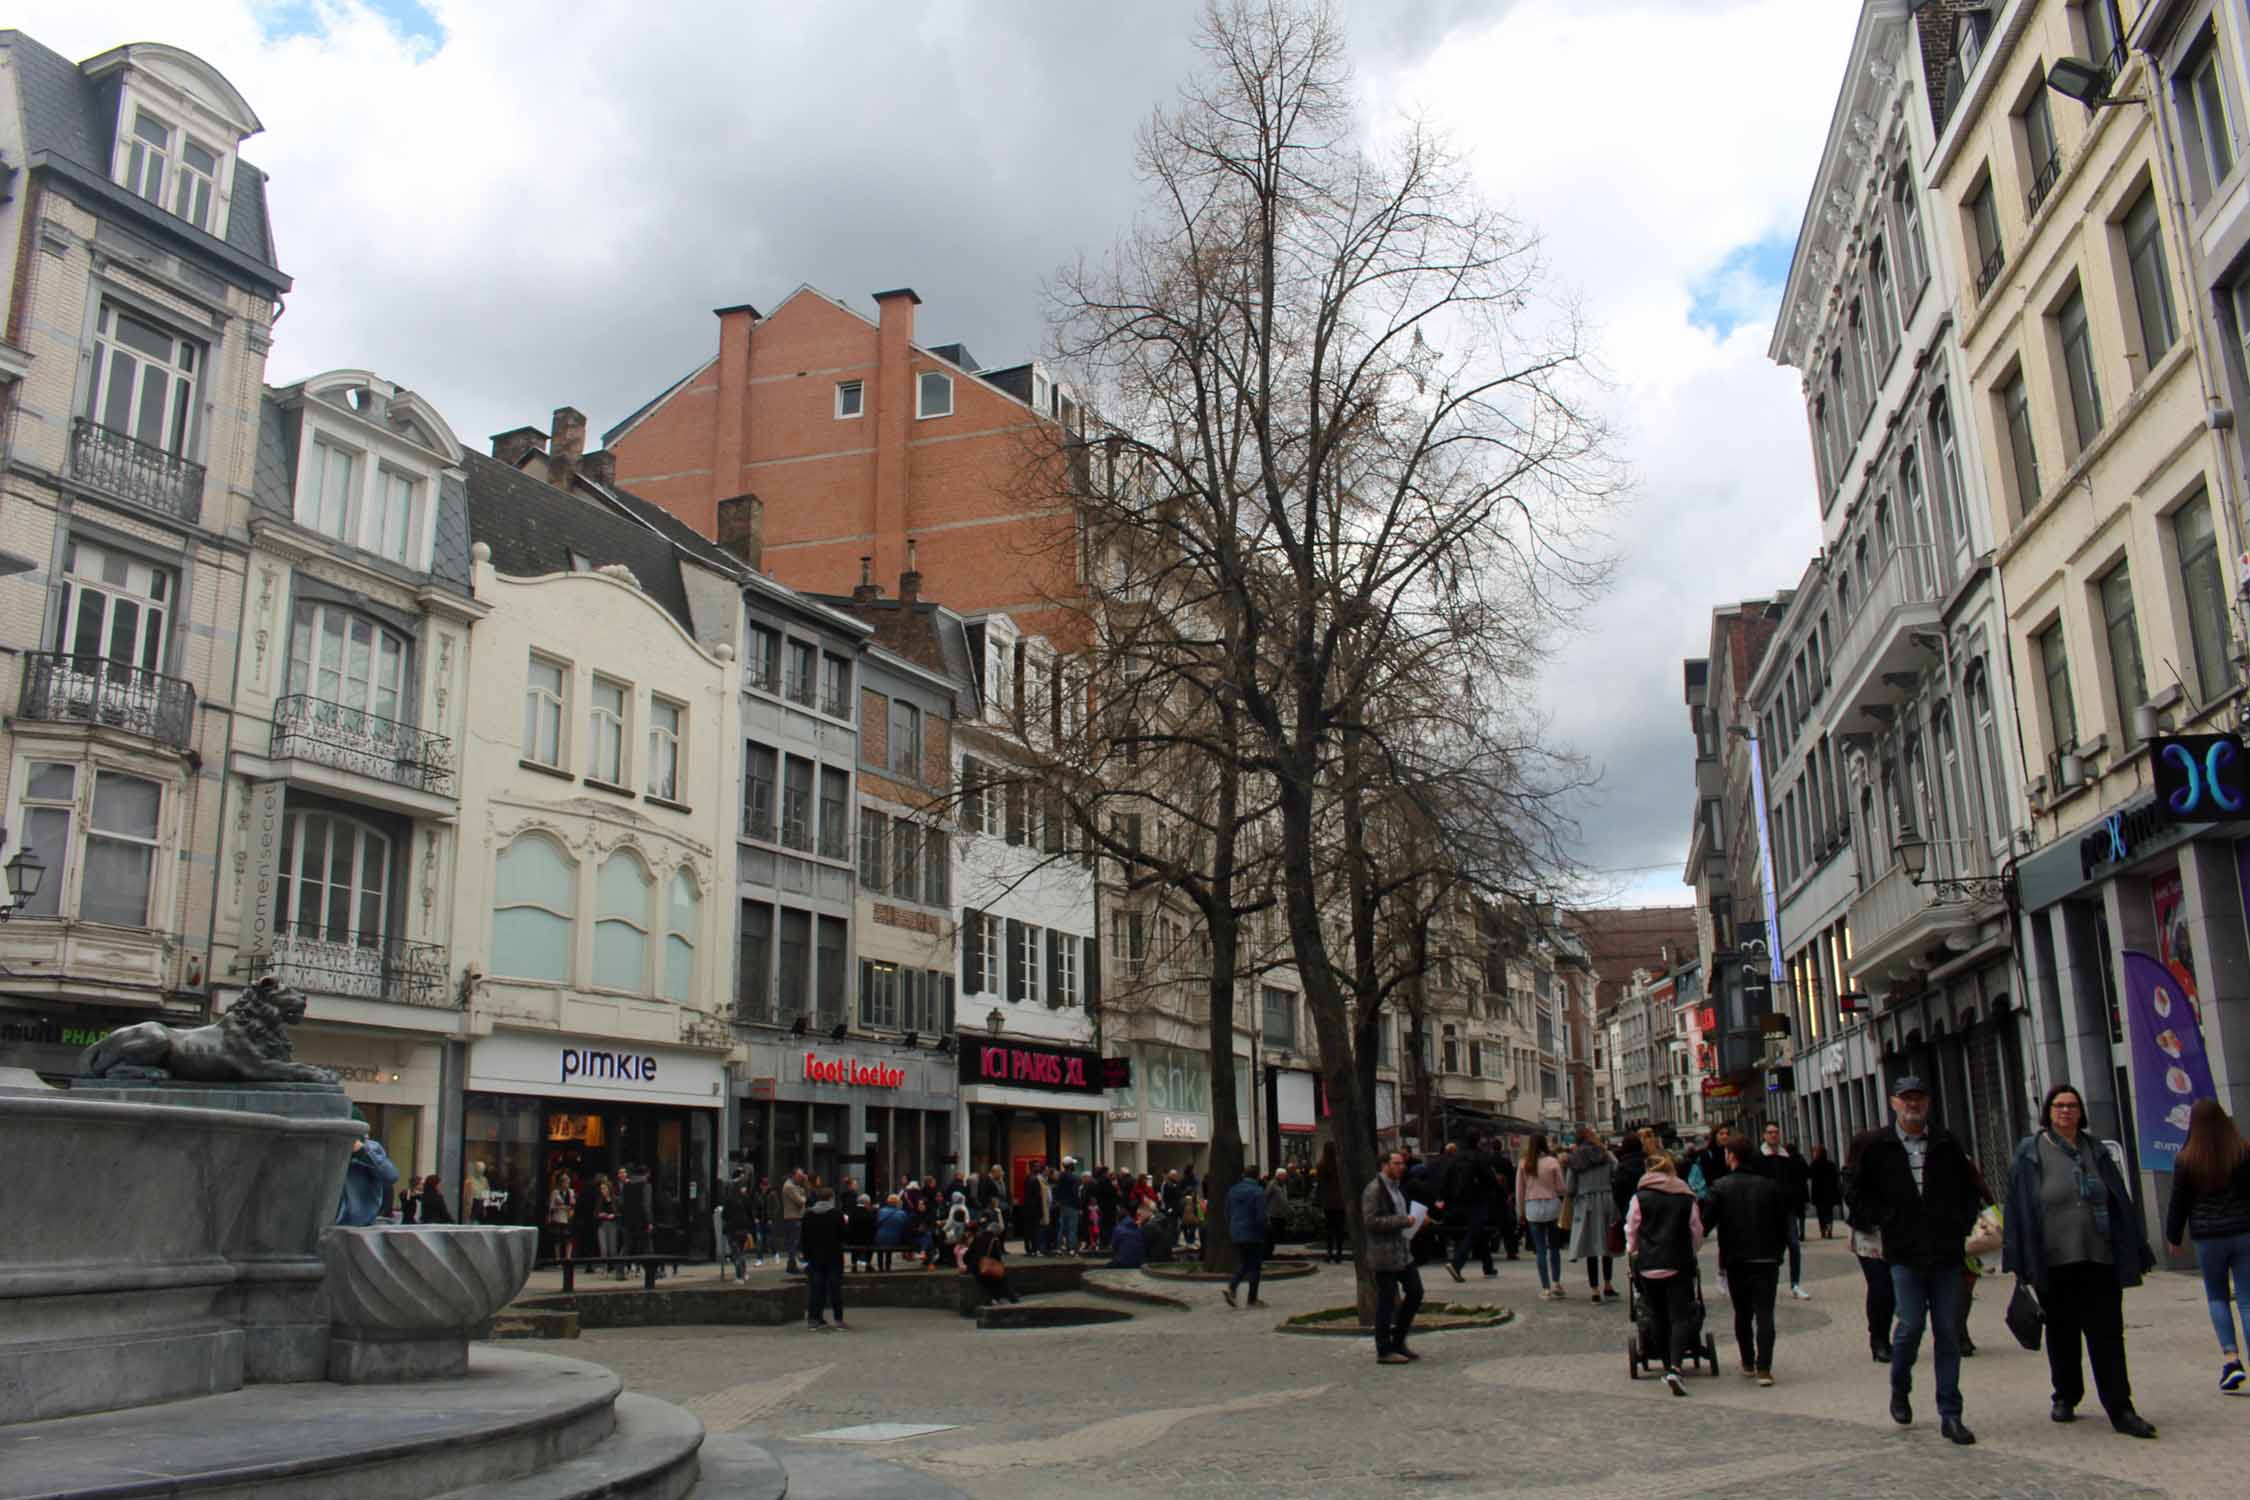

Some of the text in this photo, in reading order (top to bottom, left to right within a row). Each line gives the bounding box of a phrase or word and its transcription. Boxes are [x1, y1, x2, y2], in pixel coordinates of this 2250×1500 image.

[561, 1048, 657, 1082] pimkie
[804, 1051, 905, 1088] Foot Locker
[980, 1047, 1009, 1079] ICI
[1011, 1050, 1062, 1084] PARIS
[1063, 1056, 1087, 1087] XL
